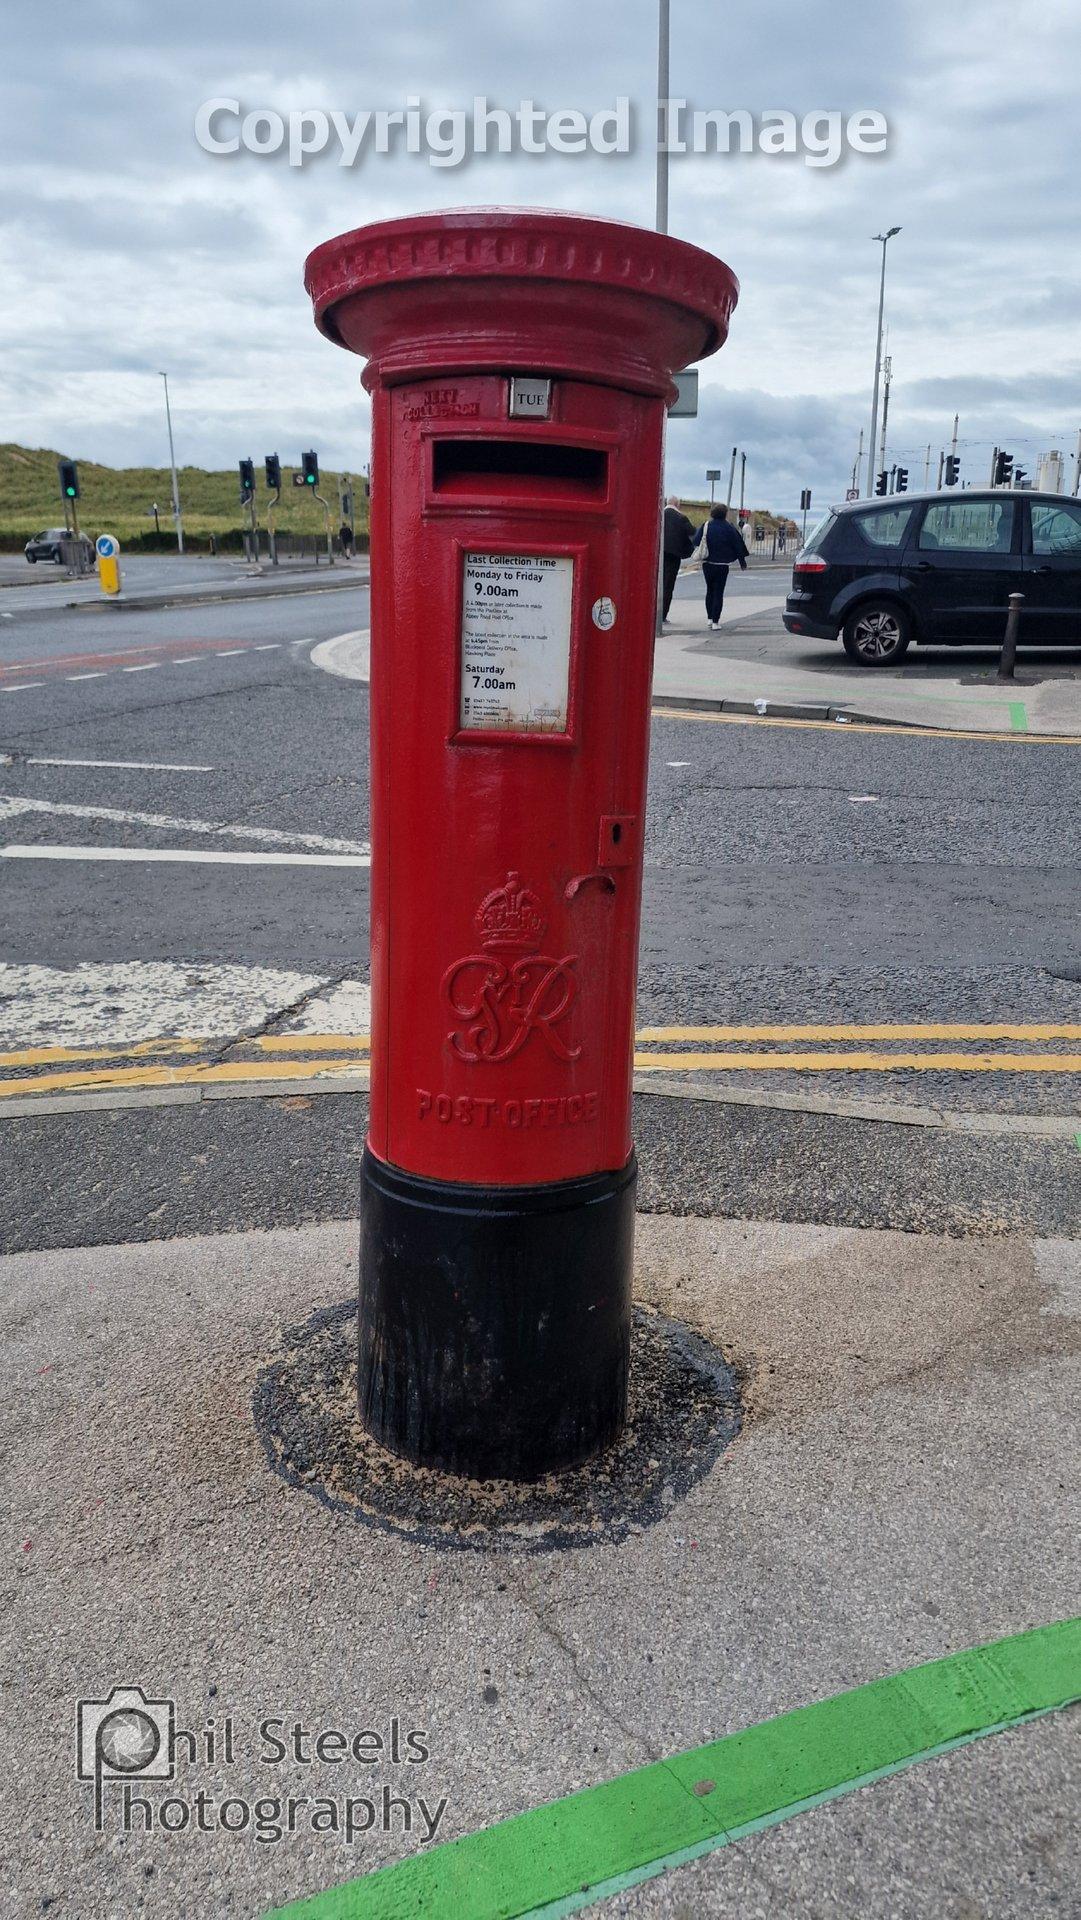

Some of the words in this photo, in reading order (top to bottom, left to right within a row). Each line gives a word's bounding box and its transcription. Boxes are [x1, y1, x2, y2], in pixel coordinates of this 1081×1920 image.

[517, 393, 545, 406] TUE
[467, 554, 486, 564] Last
[489, 555, 532, 566] Collection
[534, 557, 557, 567] Time
[467, 569, 502, 581] Monday
[504, 571, 513, 580] to
[516, 571, 544, 583] Friday
[474, 582, 519, 597] 9.00am
[465, 663, 505, 675] Saturday
[472, 675, 516, 690] 7.00am
[416, 1088, 498, 1127] POST
[503, 1091, 600, 1129] OFFICE
